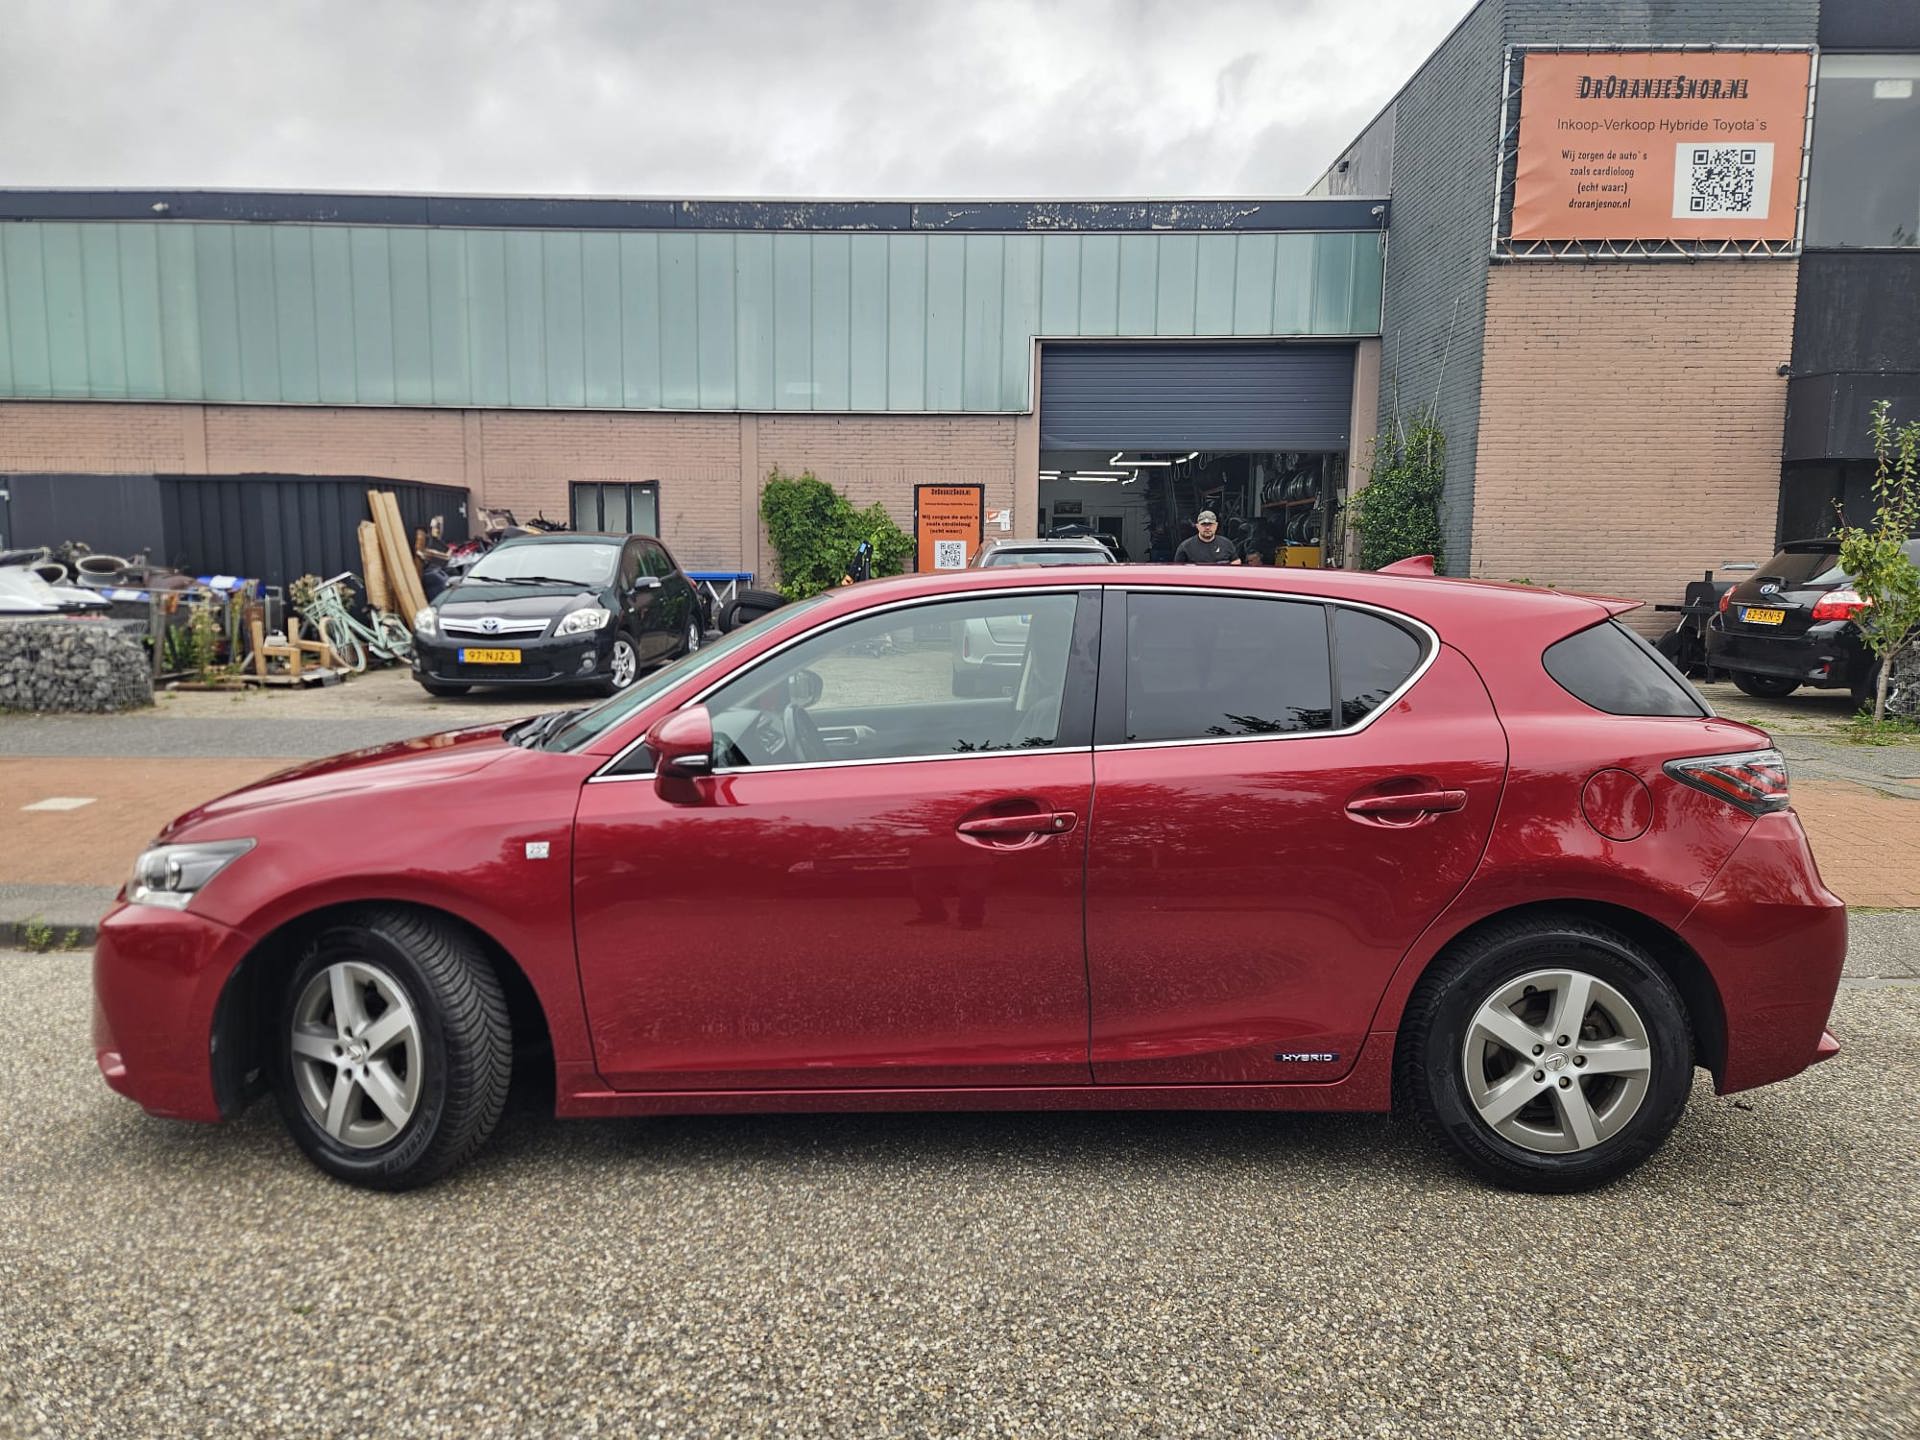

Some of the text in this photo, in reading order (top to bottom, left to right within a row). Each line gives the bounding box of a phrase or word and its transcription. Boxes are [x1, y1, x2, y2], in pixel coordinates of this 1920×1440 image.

[1557, 118, 1656, 132] Inkoop-Verkoop
[1659, 118, 1708, 132] Hybride
[1561, 149, 1576, 162] Wij
[1577, 152, 1604, 162] zorgen
[1606, 149, 1617, 160] de
[1569, 166, 1635, 178] zoals cardioloog
[1577, 182, 1628, 194] (echt waar:)
[1568, 198, 1631, 211] droranjesnor.nl
[1282, 1054, 1333, 1062] HYBRID
